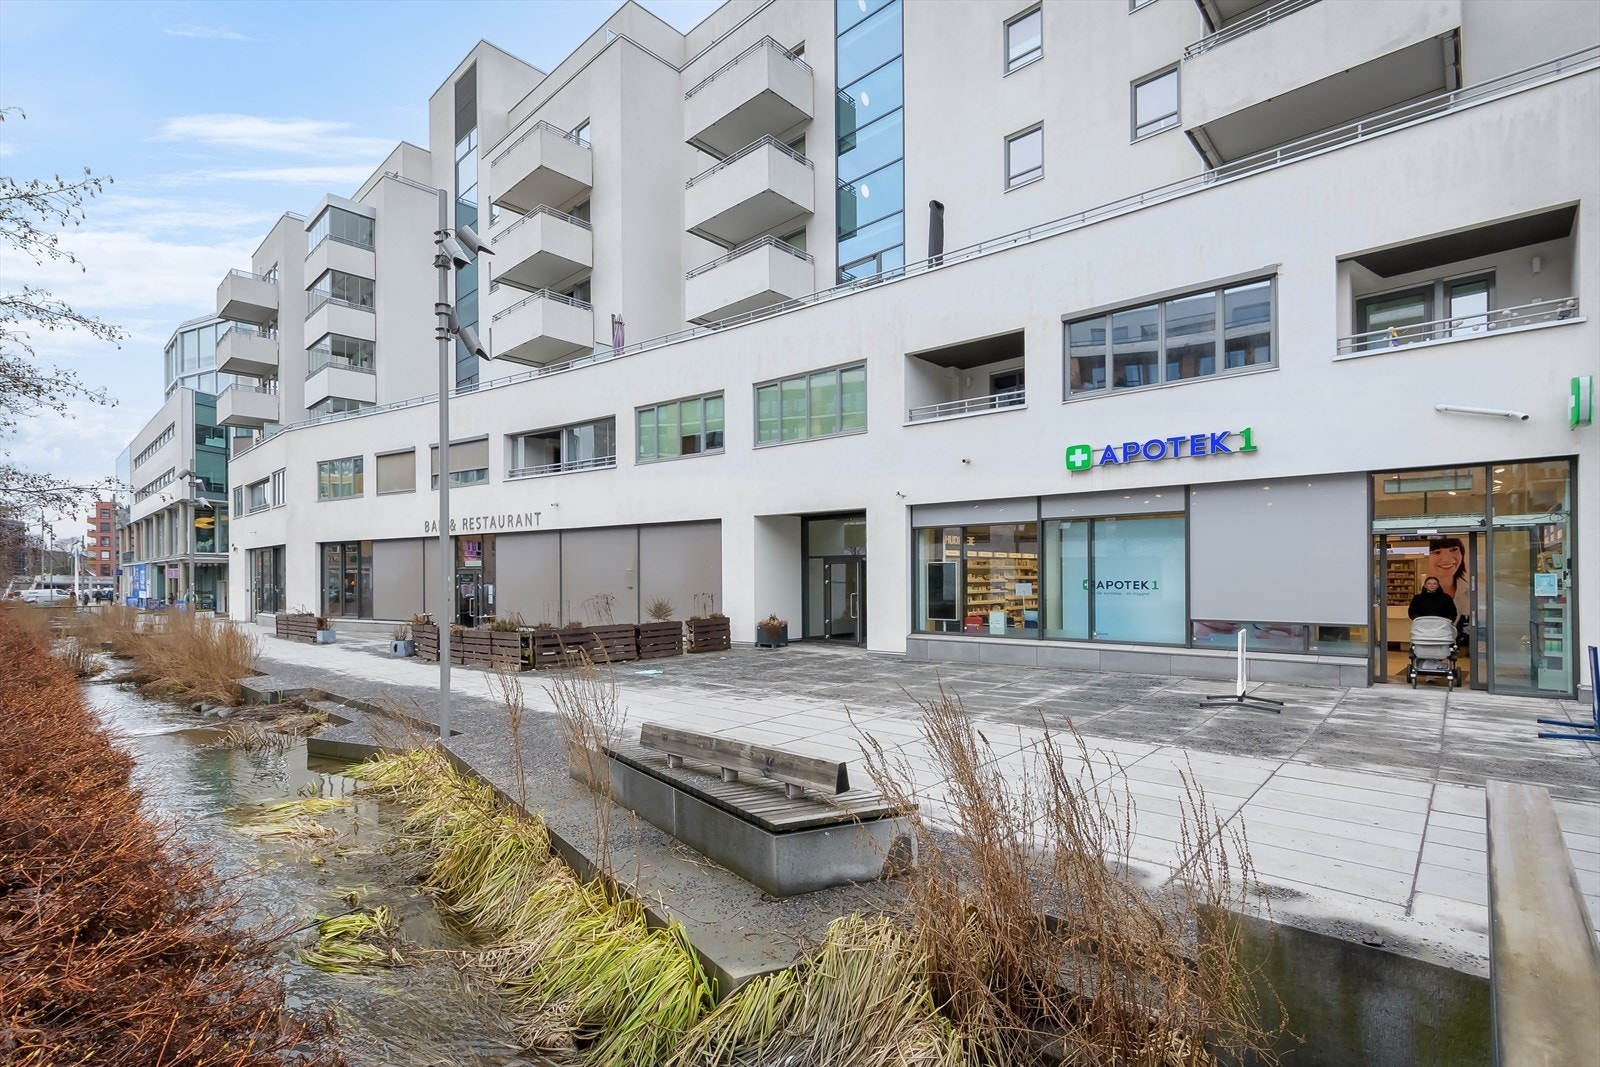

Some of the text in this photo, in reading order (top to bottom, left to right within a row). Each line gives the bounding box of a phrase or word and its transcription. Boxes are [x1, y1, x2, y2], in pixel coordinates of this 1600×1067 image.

[1099, 427, 1258, 466] APOTEK 1
[424, 512, 541, 533] BA & RESTAURANT
[1096, 580, 1159, 590] APOTEK 1
